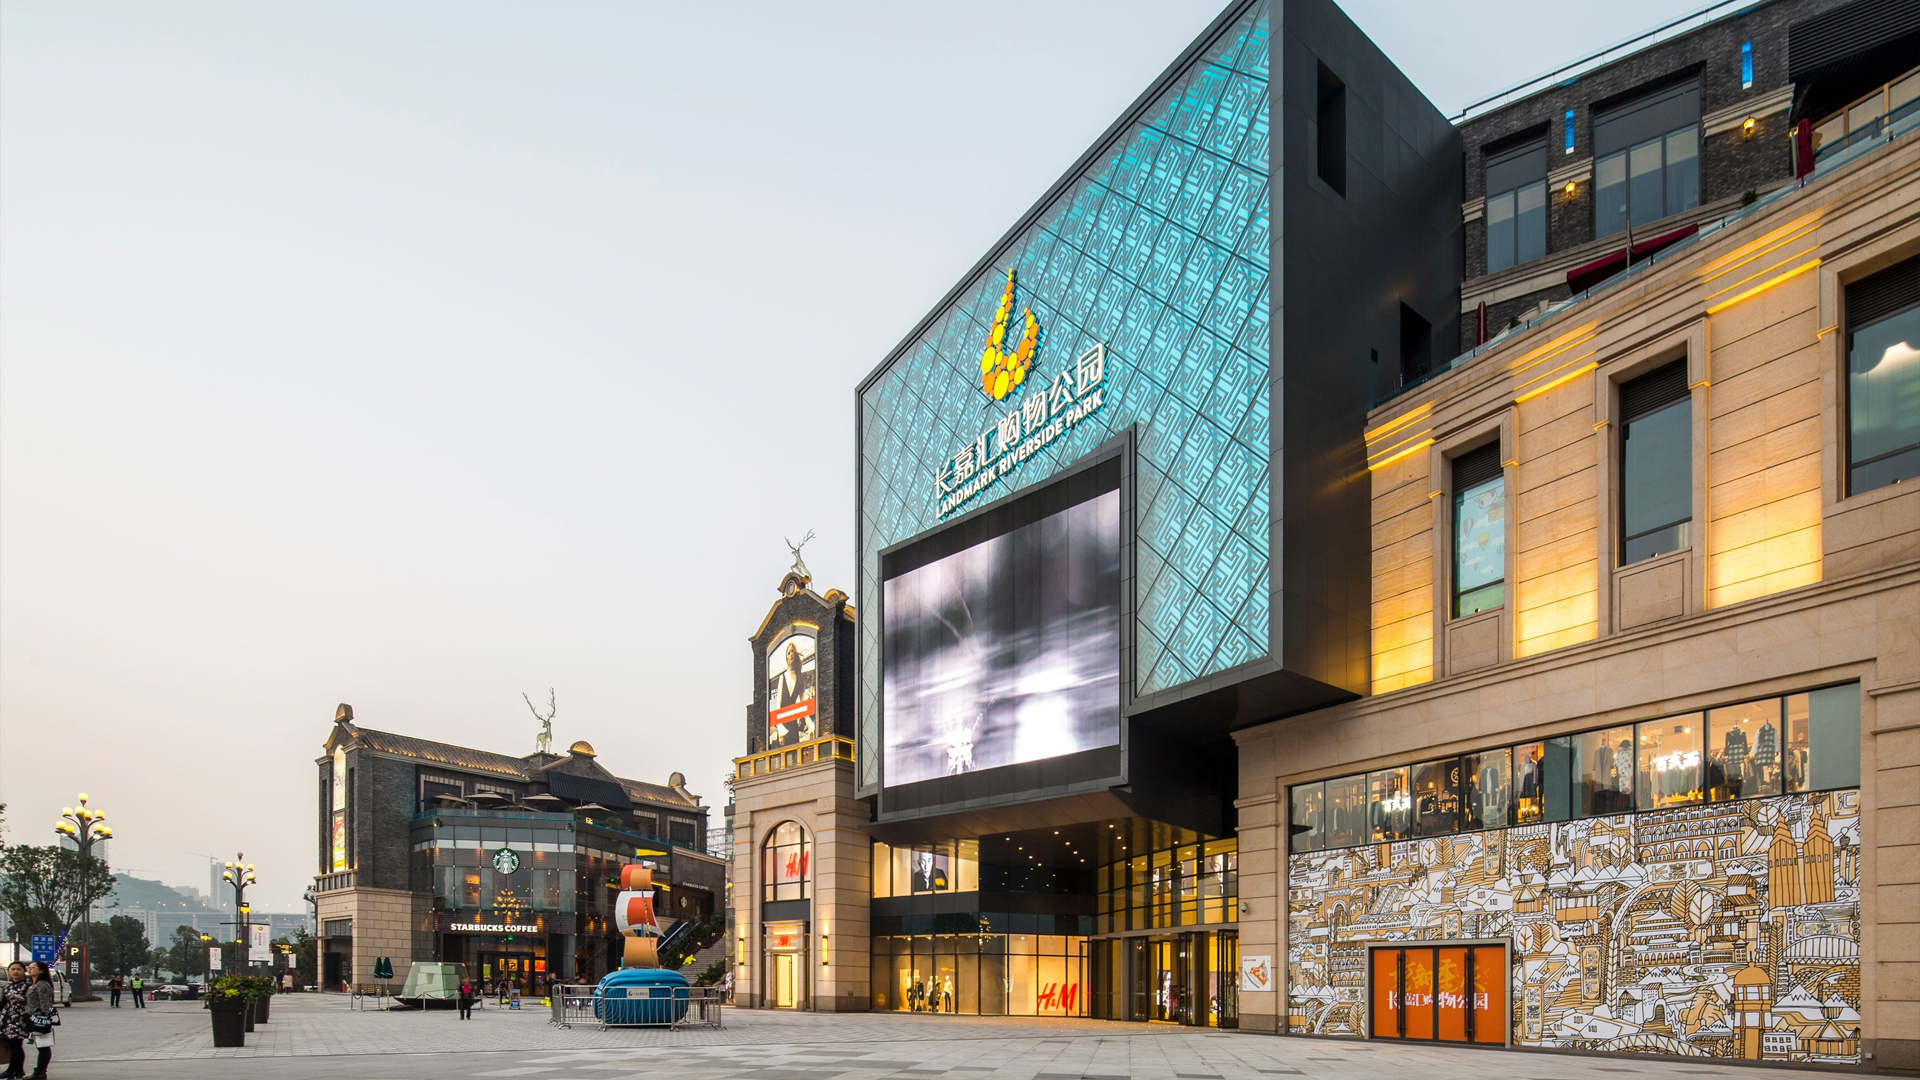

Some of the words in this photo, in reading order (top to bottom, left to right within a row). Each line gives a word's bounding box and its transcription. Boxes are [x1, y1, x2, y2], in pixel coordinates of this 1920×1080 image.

[934, 342, 1104, 499] 长嘉汇购物公园
[936, 467, 997, 519] LANDMARK
[999, 419, 1063, 475] RIVERSIDE
[1066, 388, 1104, 428] PARK
[1837, 791, 1858, 811] 汇
[785, 850, 810, 878] H&M
[1650, 861, 1708, 881] 长嘉汇
[450, 923, 504, 932] STARBUCKS
[504, 924, 538, 933] COFFEE
[1802, 922, 1849, 936] 长嘉汇
[71, 947, 79, 956] P
[71, 961, 79, 974] 出口
[1585, 951, 1599, 994] 长嘉汇
[1037, 982, 1078, 1011] H&M
[1526, 988, 1541, 1035] 长嘉汇
